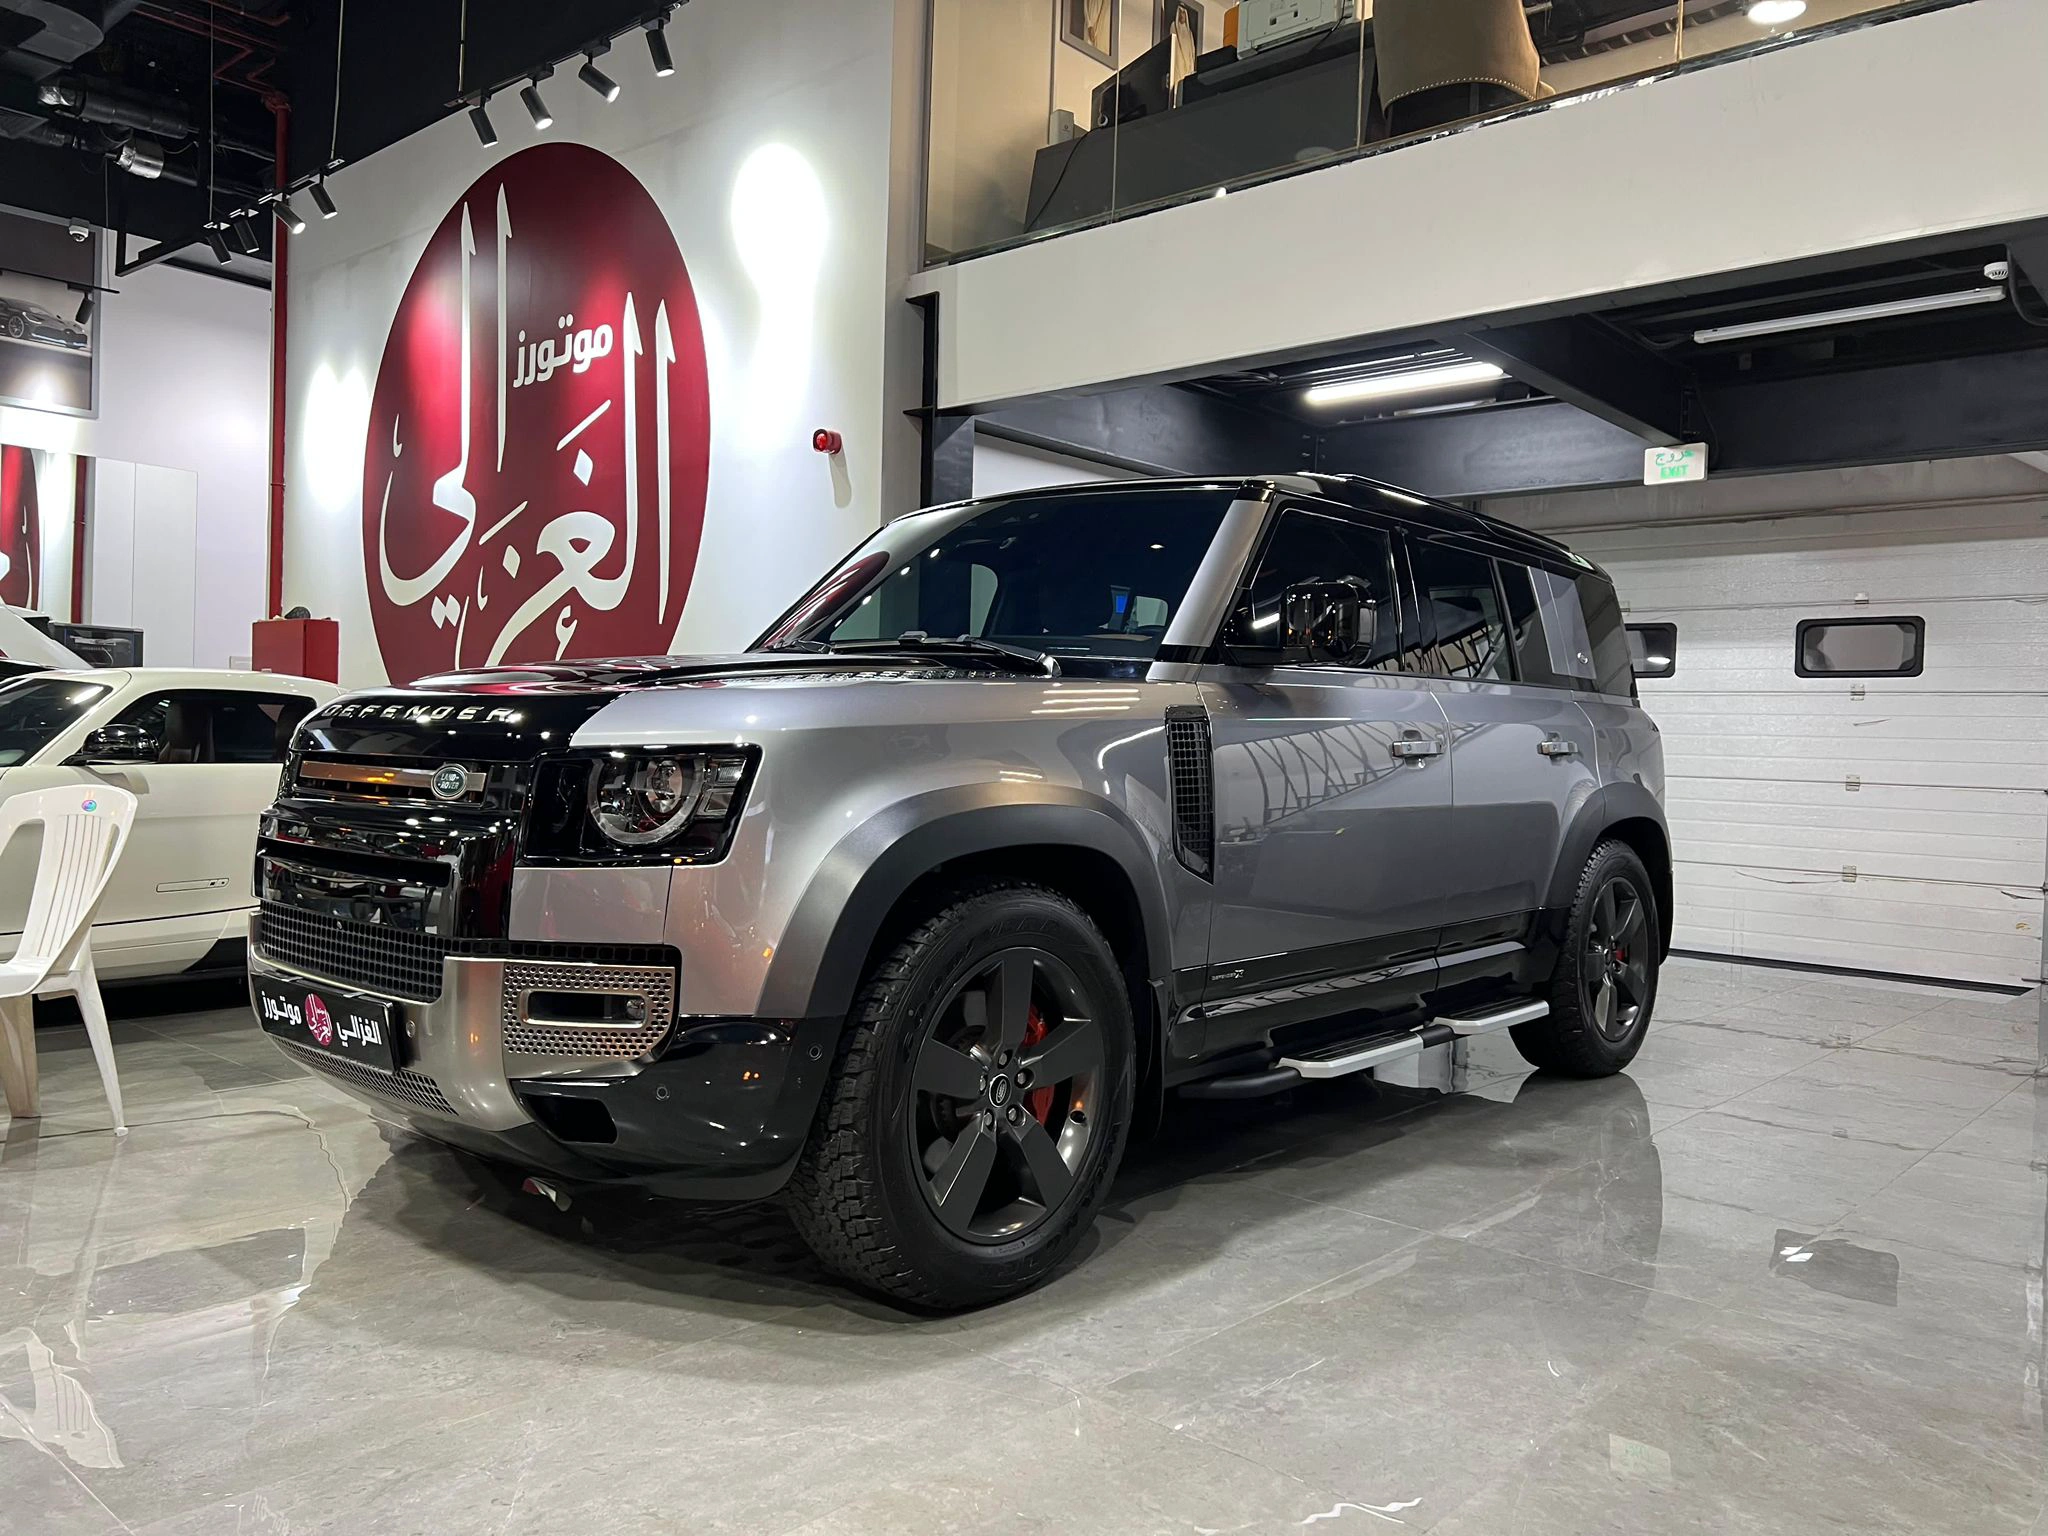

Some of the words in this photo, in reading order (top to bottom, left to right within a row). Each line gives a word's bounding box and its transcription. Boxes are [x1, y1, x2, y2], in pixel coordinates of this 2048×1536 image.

[513, 314, 613, 388] موتورز
[1660, 465, 1688, 479] EXIT
[321, 704, 516, 722] DEFENDER
[261, 990, 302, 1025] موتورز
[336, 1014, 382, 1047] الغزالي
